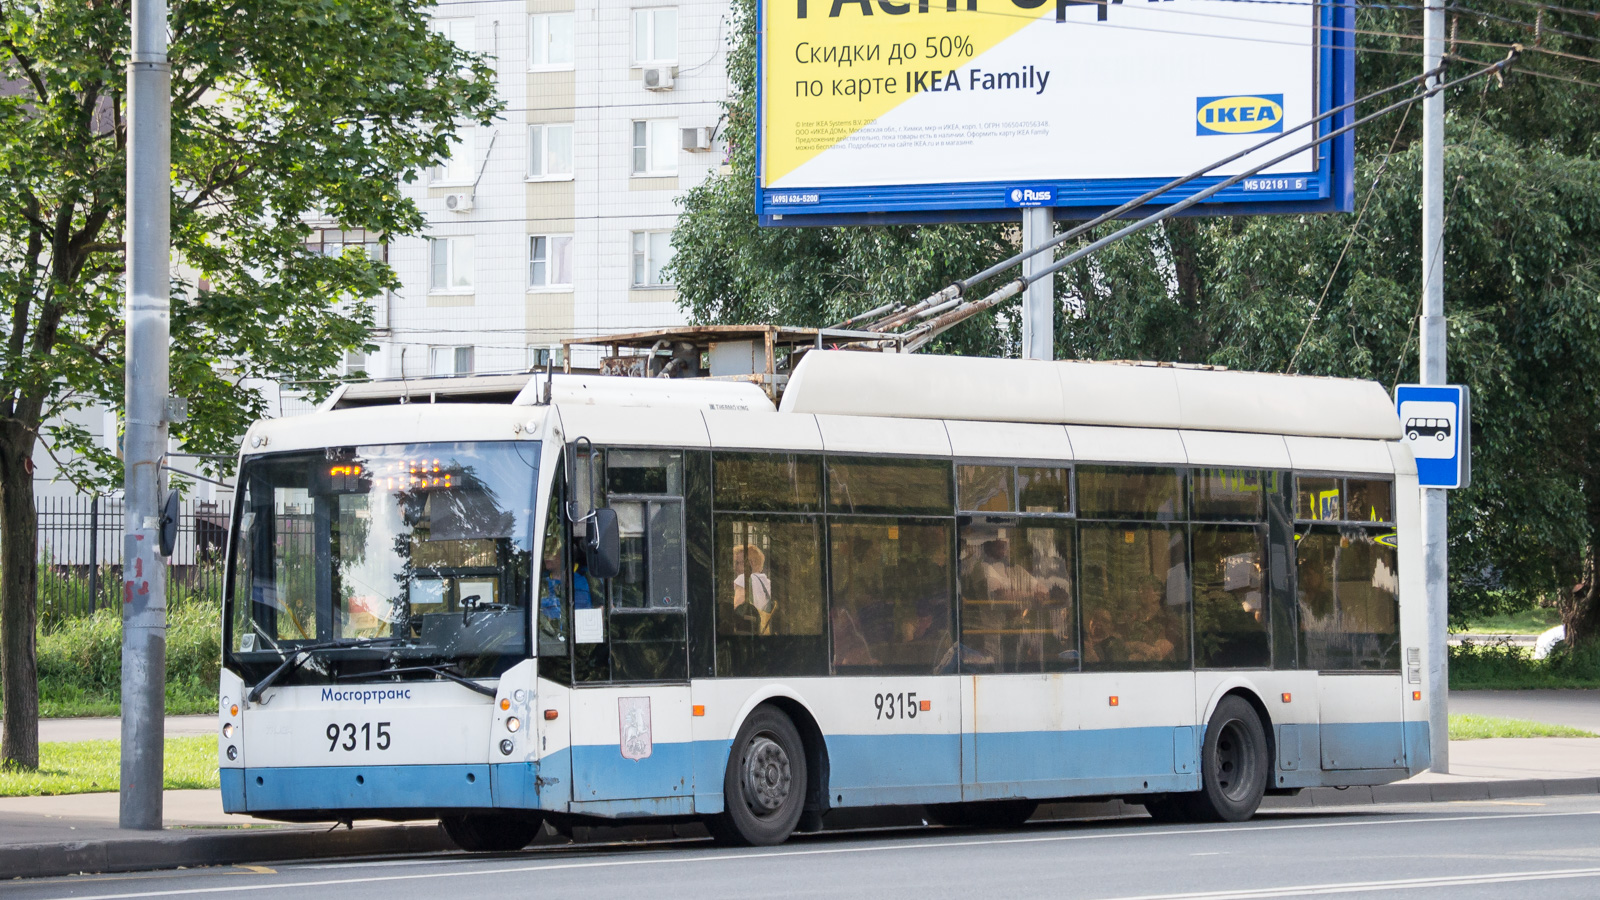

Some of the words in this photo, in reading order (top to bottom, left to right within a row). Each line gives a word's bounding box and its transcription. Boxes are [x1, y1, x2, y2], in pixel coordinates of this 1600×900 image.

[795, 42, 880, 67] Скидки
[888, 42, 917, 65] до
[925, 35, 974, 58] 50%
[795, 80, 824, 97] по
[832, 77, 897, 102] карте
[906, 70, 961, 93] IKEA
[970, 66, 1050, 94] Family
[1205, 106, 1276, 123] IKEA
[1245, 181, 1258, 190] MS
[1260, 180, 1288, 189] 02181
[773, 195, 788, 204] (495)
[789, 194, 818, 203] 626-5200
[1024, 190, 1051, 201] Russ
[321, 688, 411, 704] Мосгортранс
[874, 692, 917, 720] 9315
[326, 722, 391, 752] 9315
